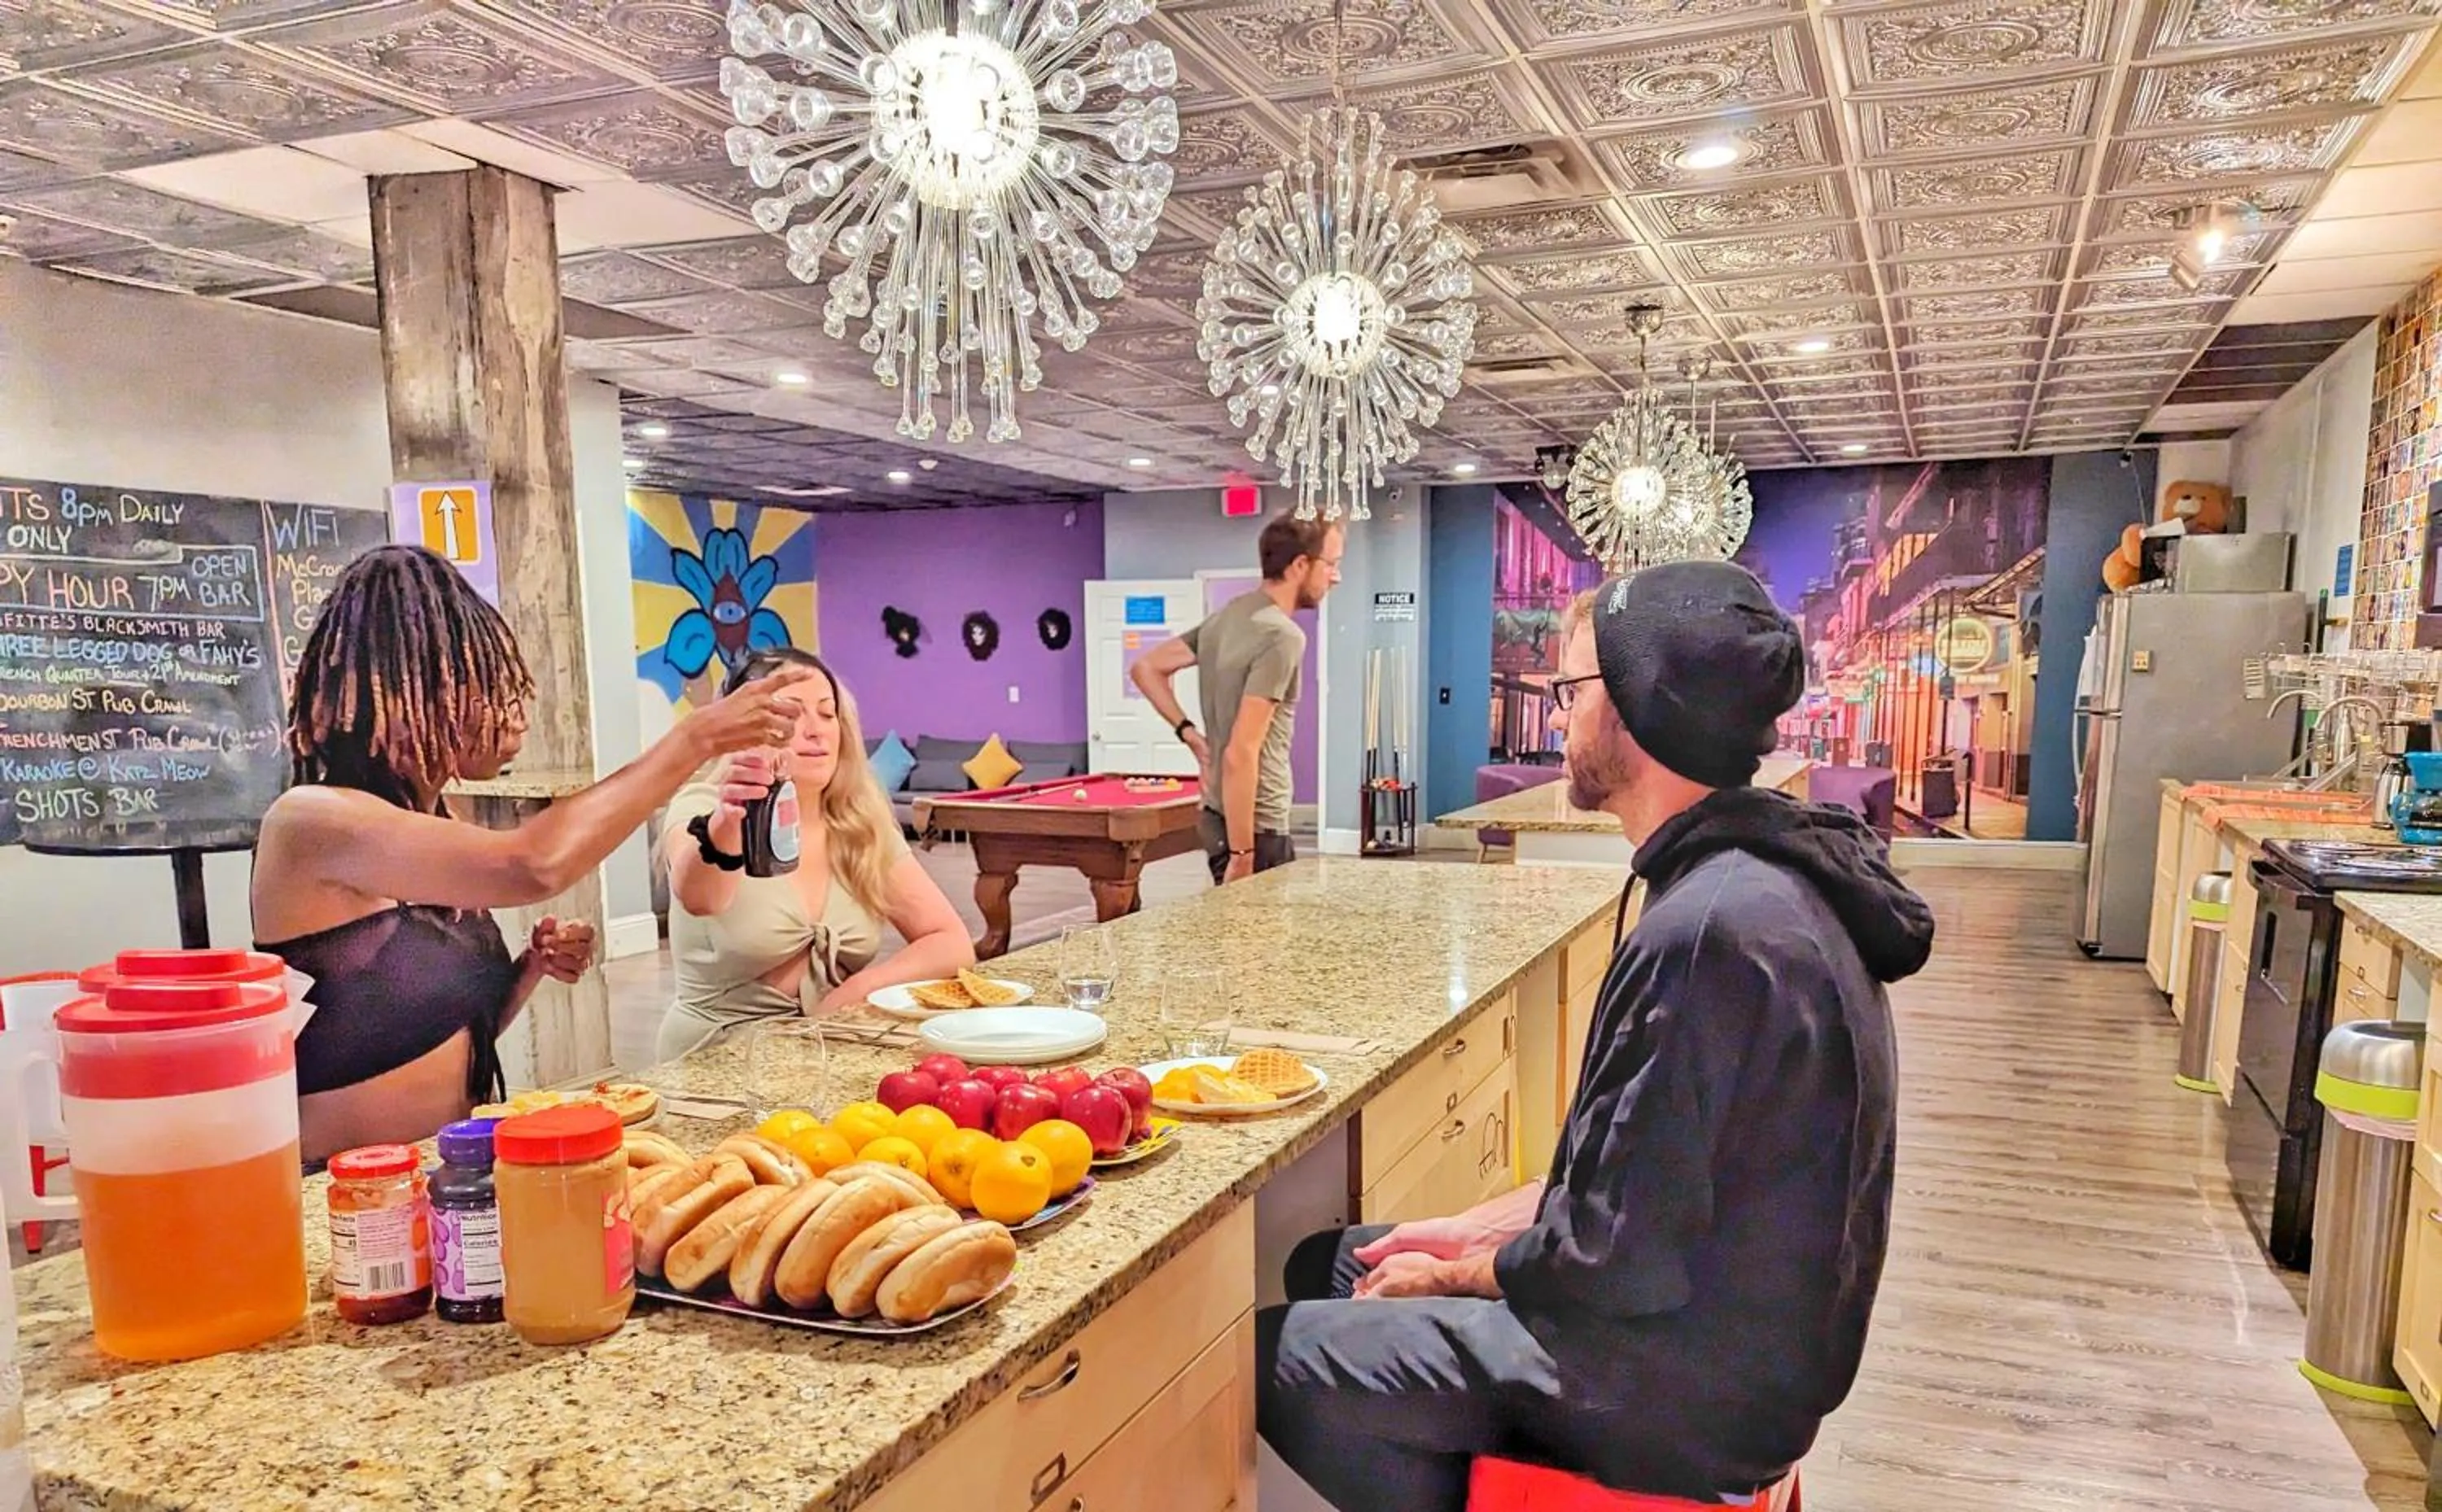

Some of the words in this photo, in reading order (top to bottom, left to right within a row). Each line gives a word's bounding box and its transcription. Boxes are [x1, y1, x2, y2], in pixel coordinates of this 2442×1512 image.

[0, 487, 50, 521] TS
[120, 494, 184, 524] DAILY
[7, 524, 72, 554] ONLY
[191, 555, 247, 577] OPEN
[47, 569, 134, 611] HOUR
[137, 575, 191, 612] 7PM
[199, 581, 251, 607] BAR
[1378, 595, 1410, 603] NOTICE
[0, 612, 77, 631] FITTE'S
[83, 615, 190, 637] BLACKSMITH
[196, 620, 226, 640] BAR
[132, 640, 173, 663] DOG
[199, 639, 261, 669] FAHY'S
[71, 687, 96, 710] ST
[102, 689, 136, 714] PUB
[128, 727, 165, 751] PUB
[15, 787, 100, 824] SHOTS
[107, 787, 160, 816] BAR
